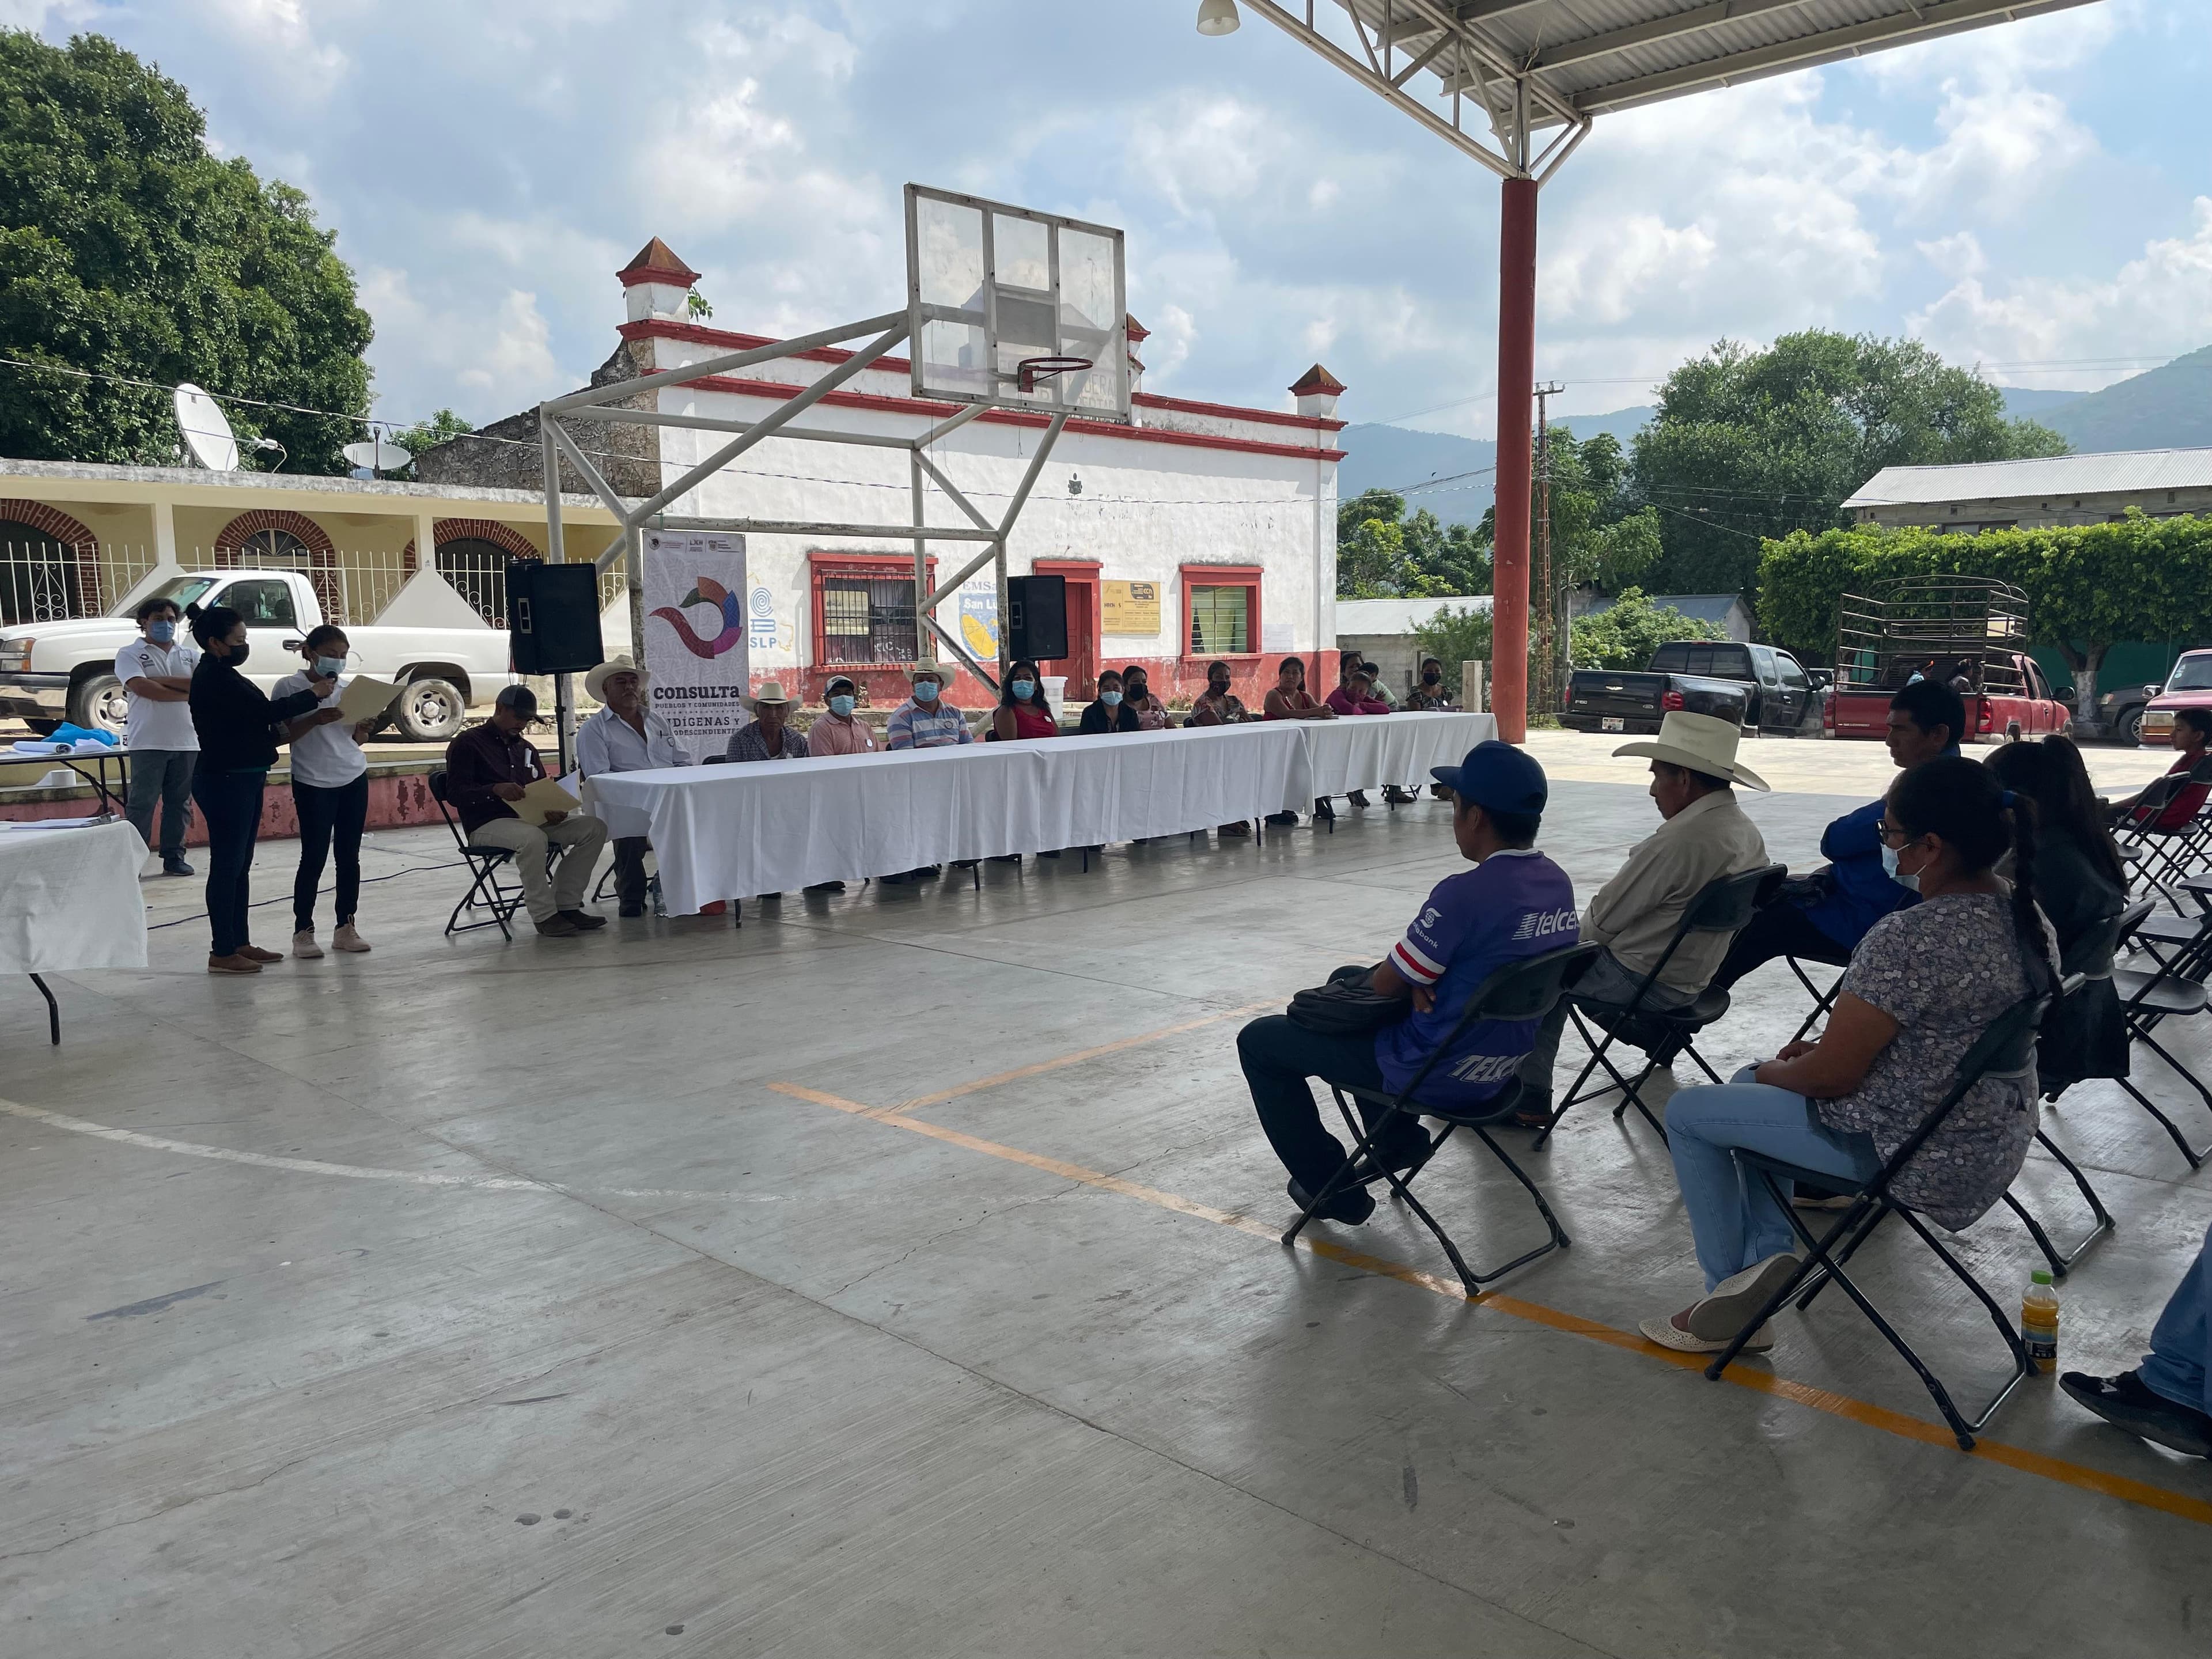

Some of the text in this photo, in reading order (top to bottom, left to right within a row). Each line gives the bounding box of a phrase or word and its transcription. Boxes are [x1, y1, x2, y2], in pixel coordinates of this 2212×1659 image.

[963, 597, 997, 609] San Lu
[750, 637, 777, 648] SLP
[667, 716, 729, 727] DÍGENAS
